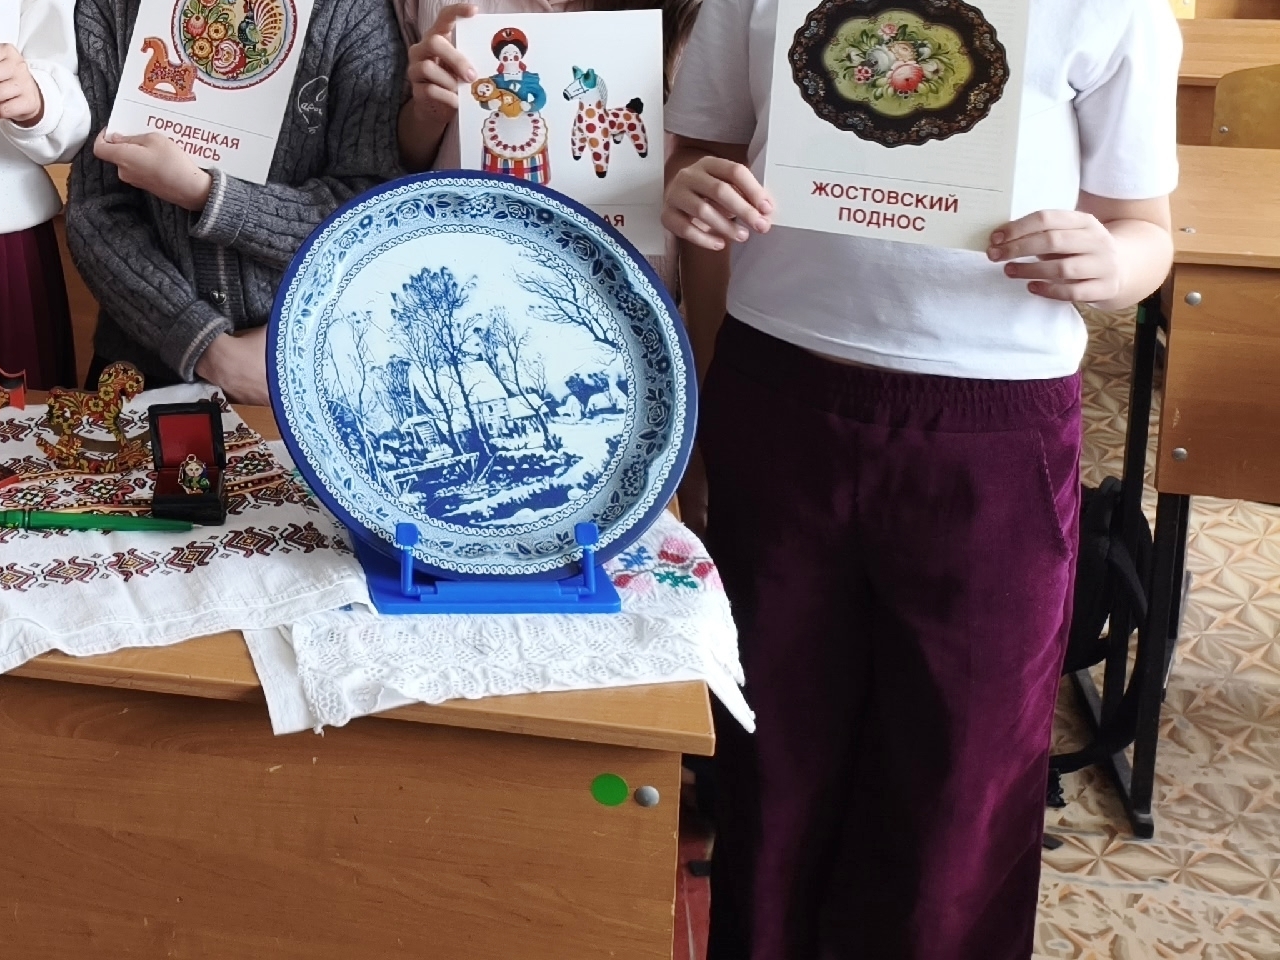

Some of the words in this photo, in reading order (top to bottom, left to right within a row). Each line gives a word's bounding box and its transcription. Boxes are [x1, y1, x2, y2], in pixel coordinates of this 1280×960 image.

[146, 115, 240, 149] ГОРОДЕЦКАЯ
[811, 180, 959, 213] ЖОСТОВСКИЙ
[838, 206, 927, 231] ПОДНОС
